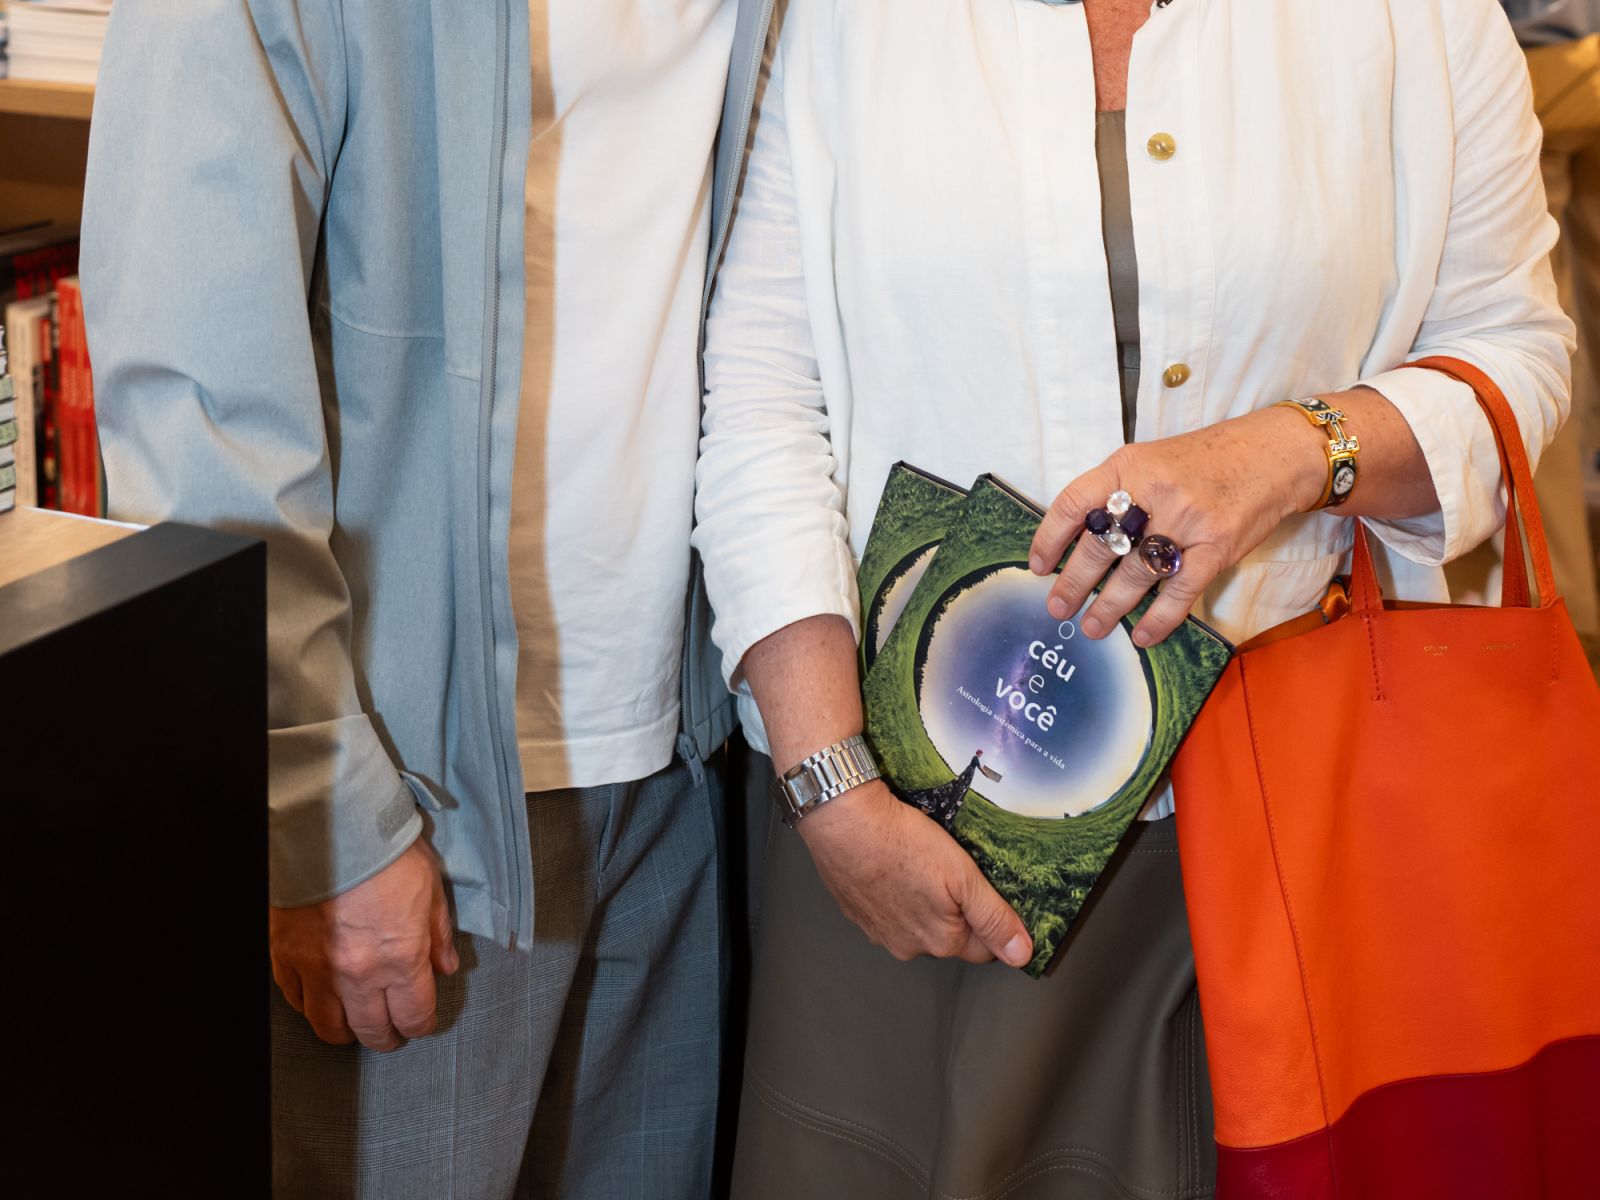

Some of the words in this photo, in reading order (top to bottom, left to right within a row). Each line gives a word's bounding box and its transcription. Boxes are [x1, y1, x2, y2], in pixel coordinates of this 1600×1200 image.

[1028, 640, 1076, 682] céu
[1028, 674, 1045, 694] e
[956, 686, 993, 716] Astrologia
[1025, 738, 1042, 753] para
[1050, 753, 1065, 769] vida
[994, 677, 1057, 732] você
